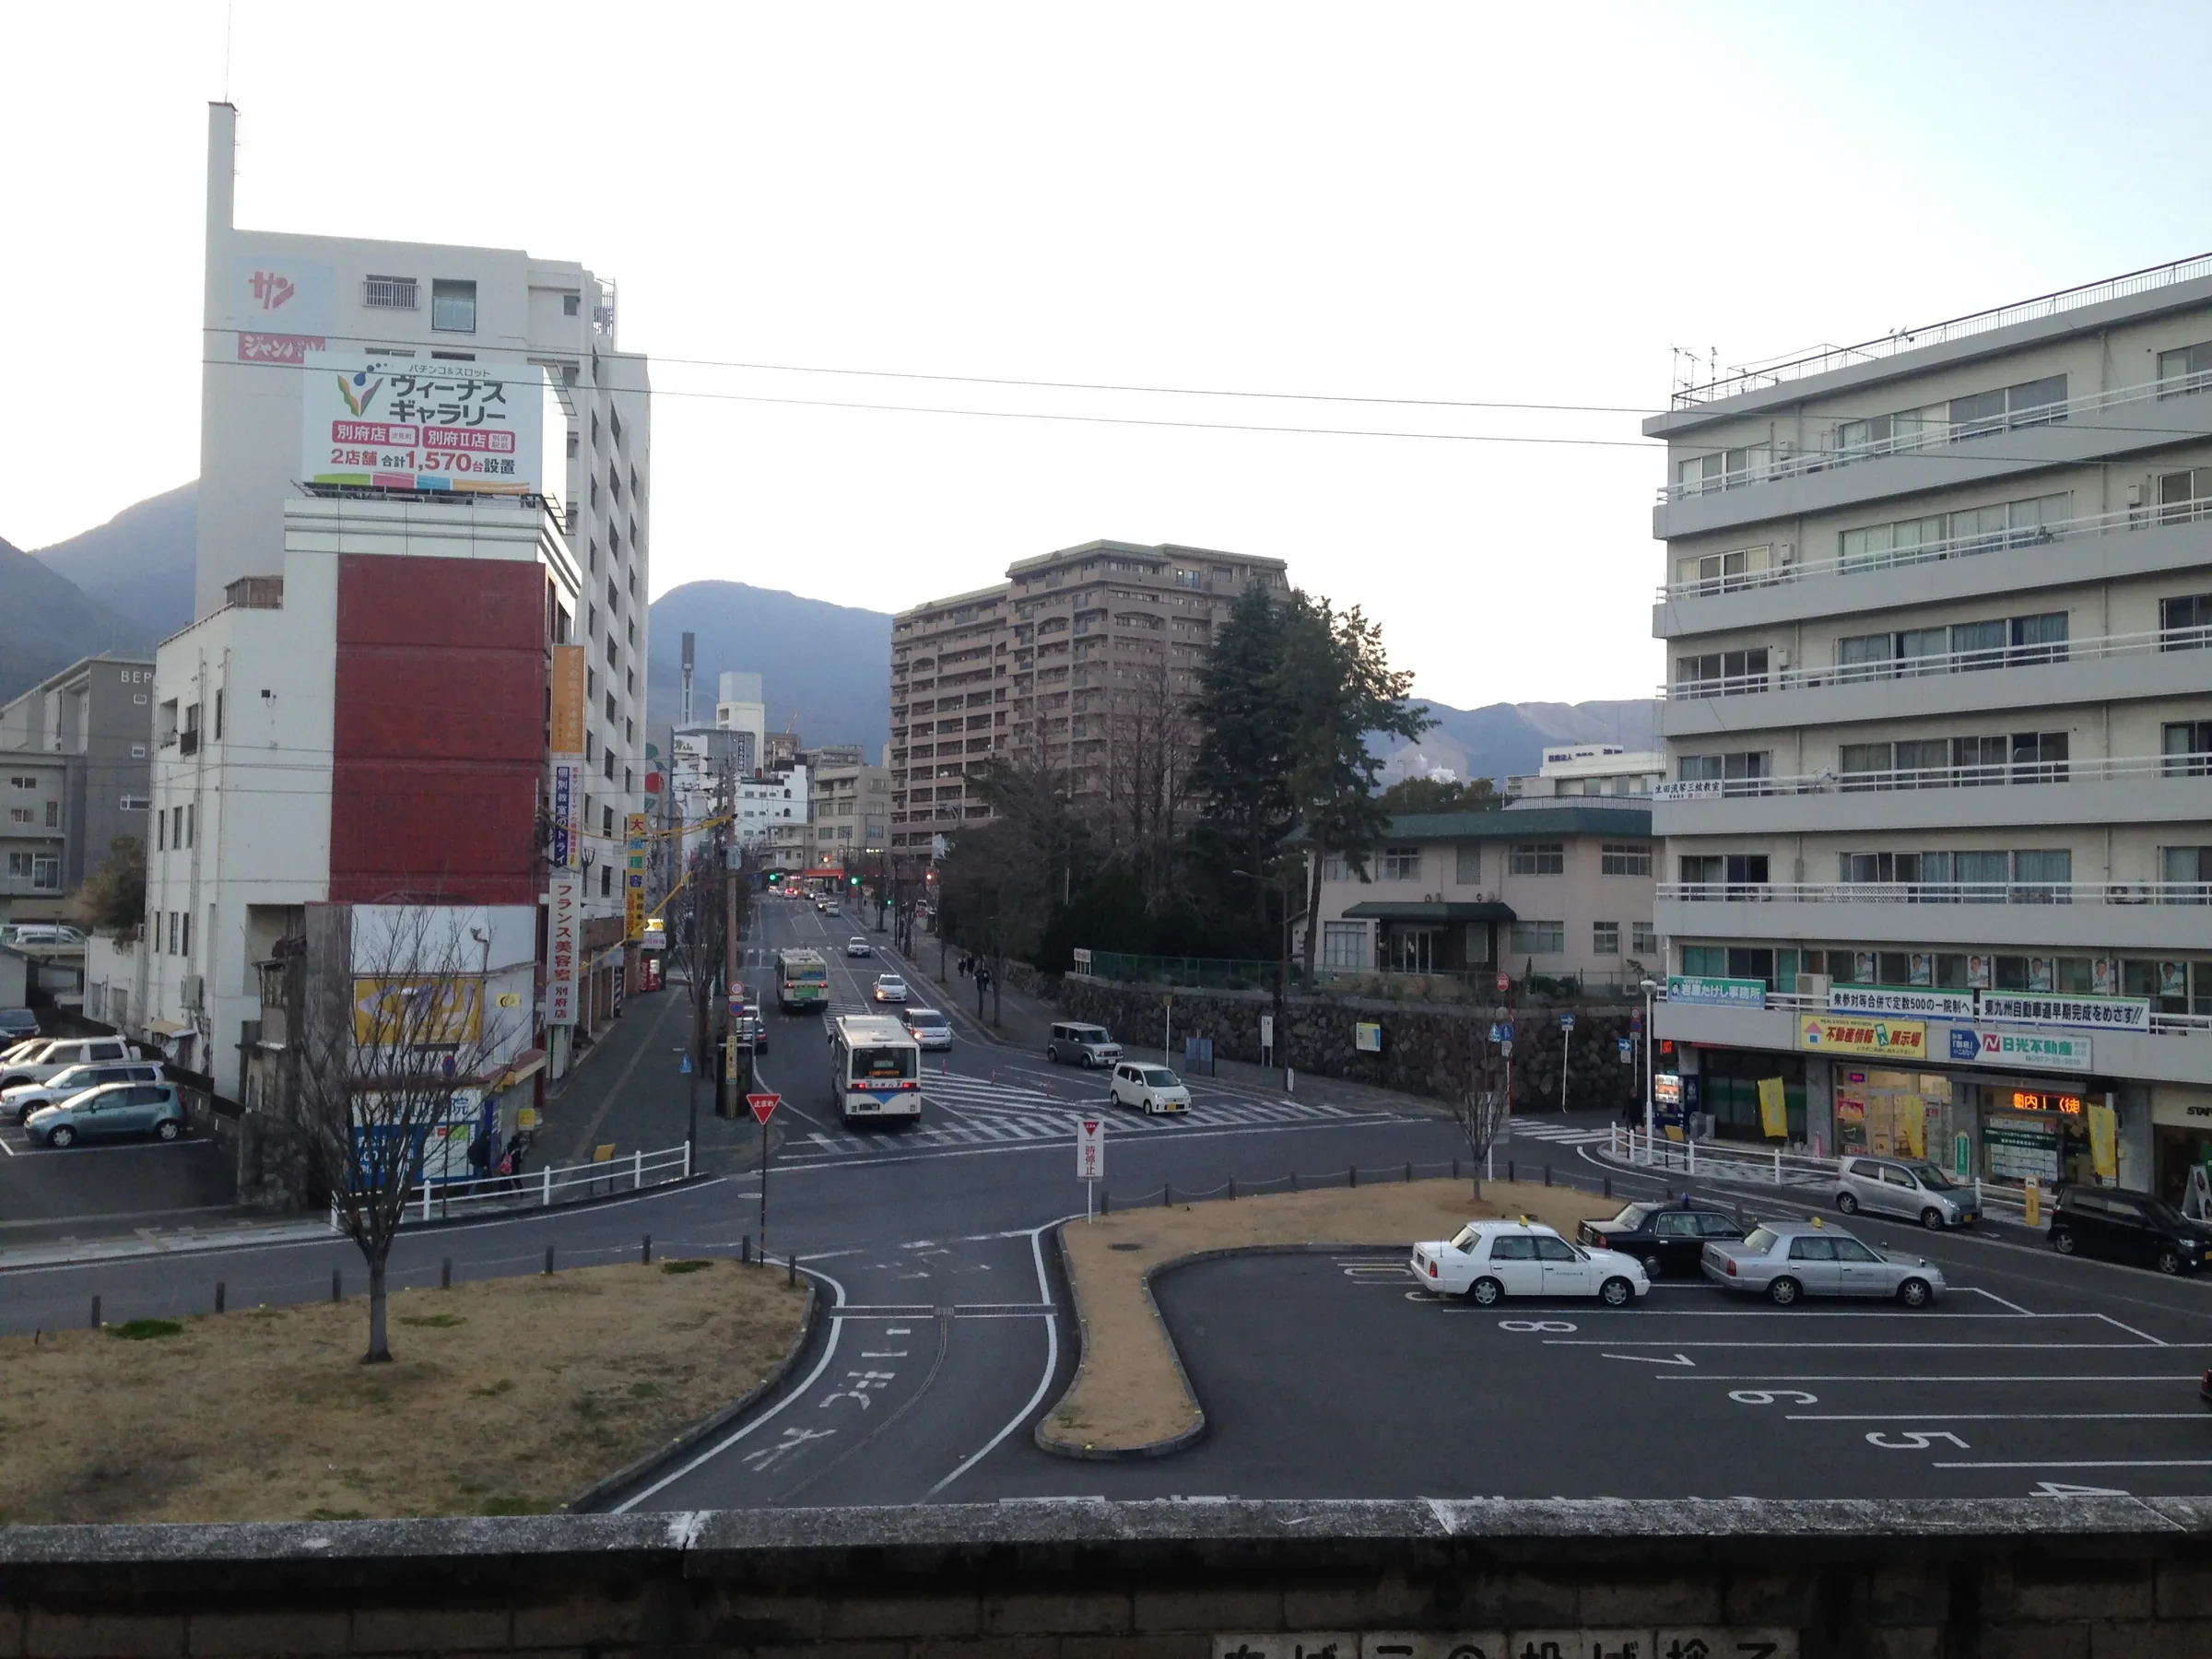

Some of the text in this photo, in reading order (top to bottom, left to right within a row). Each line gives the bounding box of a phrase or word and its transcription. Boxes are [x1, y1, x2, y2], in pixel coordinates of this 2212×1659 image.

[390, 374, 506, 404] ヴィーナス
[389, 400, 506, 426] ギャラリー
[337, 425, 386, 442] 別府店
[331, 448, 378, 466] 2店舗
[121, 671, 152, 684] BEP
[556, 767, 569, 865] 個別教室のトライ
[554, 883, 572, 1020] フランス美容室 別府店
[1681, 983, 1761, 1000] 岩屋たけし事務所
[1833, 993, 1971, 1014] 衆参対等合併で定数500の一院制へ
[1825, 1027, 1875, 1044] 不動産情報
[1889, 1030, 1922, 1048] 展示場
[2003, 1037, 2073, 1056] 日光不動産
[754, 1100, 774, 1108] 止まれ
[1498, 1321, 1578, 1333] 8
[1728, 1390, 1818, 1405] 6
[1865, 1431, 1971, 1449] 5
